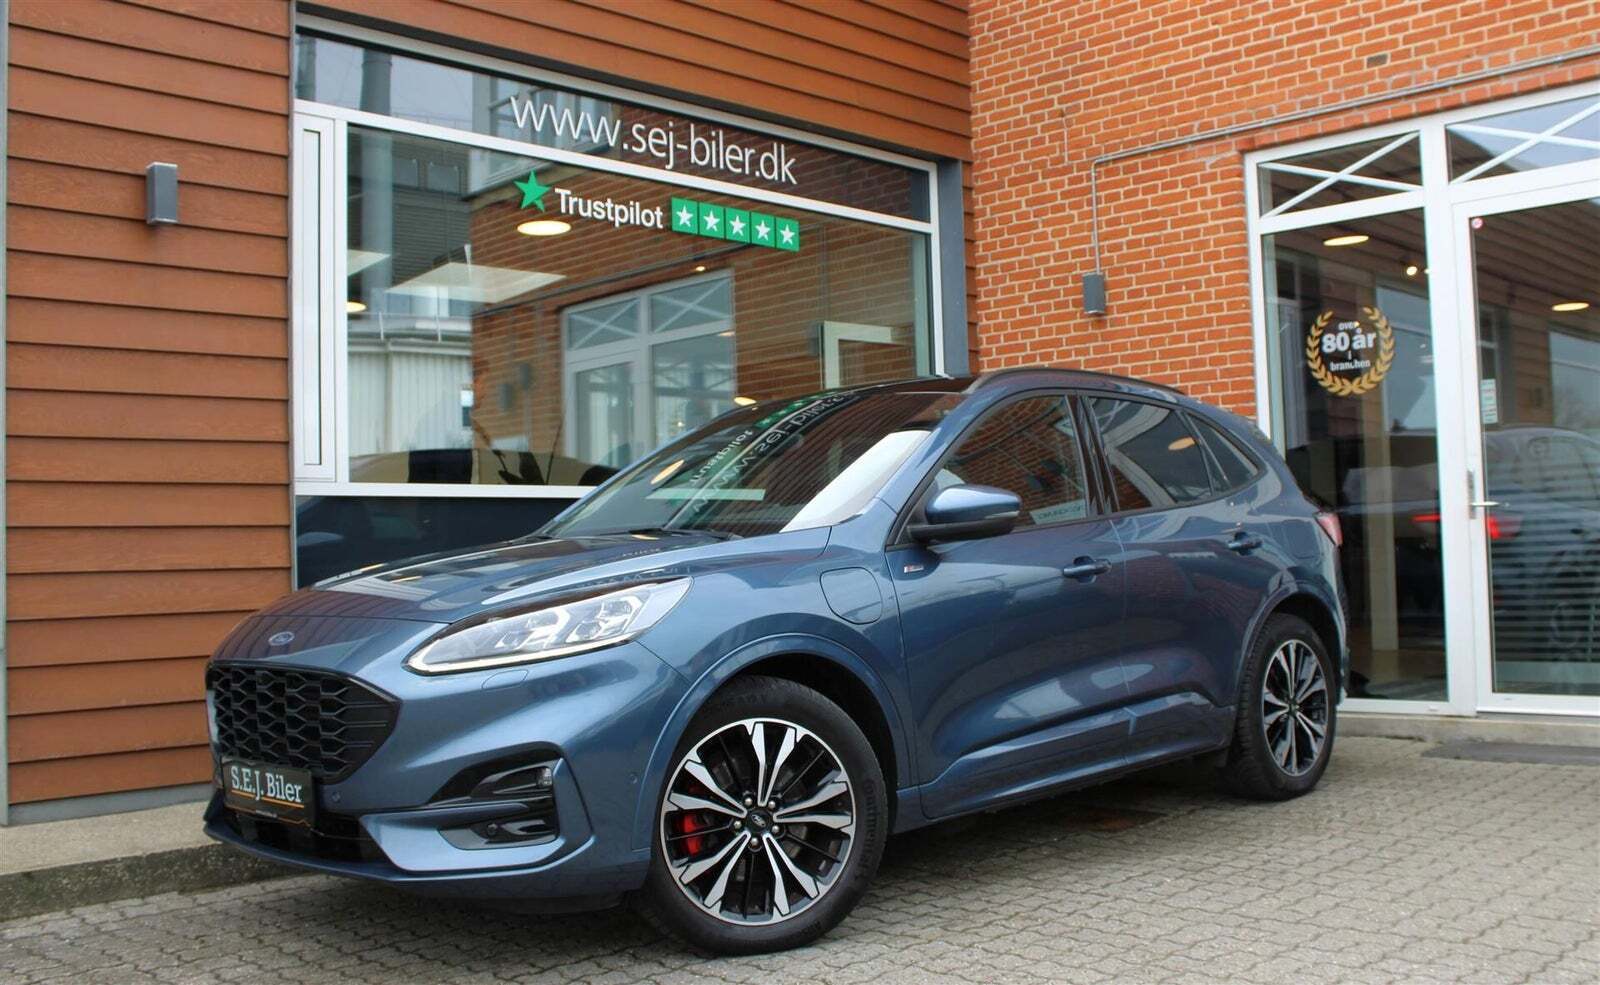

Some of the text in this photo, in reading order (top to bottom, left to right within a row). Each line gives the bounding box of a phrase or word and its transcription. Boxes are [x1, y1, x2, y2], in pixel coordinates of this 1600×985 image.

[510, 96, 797, 184] www.sej-biler.dk
[555, 188, 663, 229] Trustpilot
[1322, 328, 1376, 353] 80 år
[231, 765, 303, 803] S.E.J. Biler
